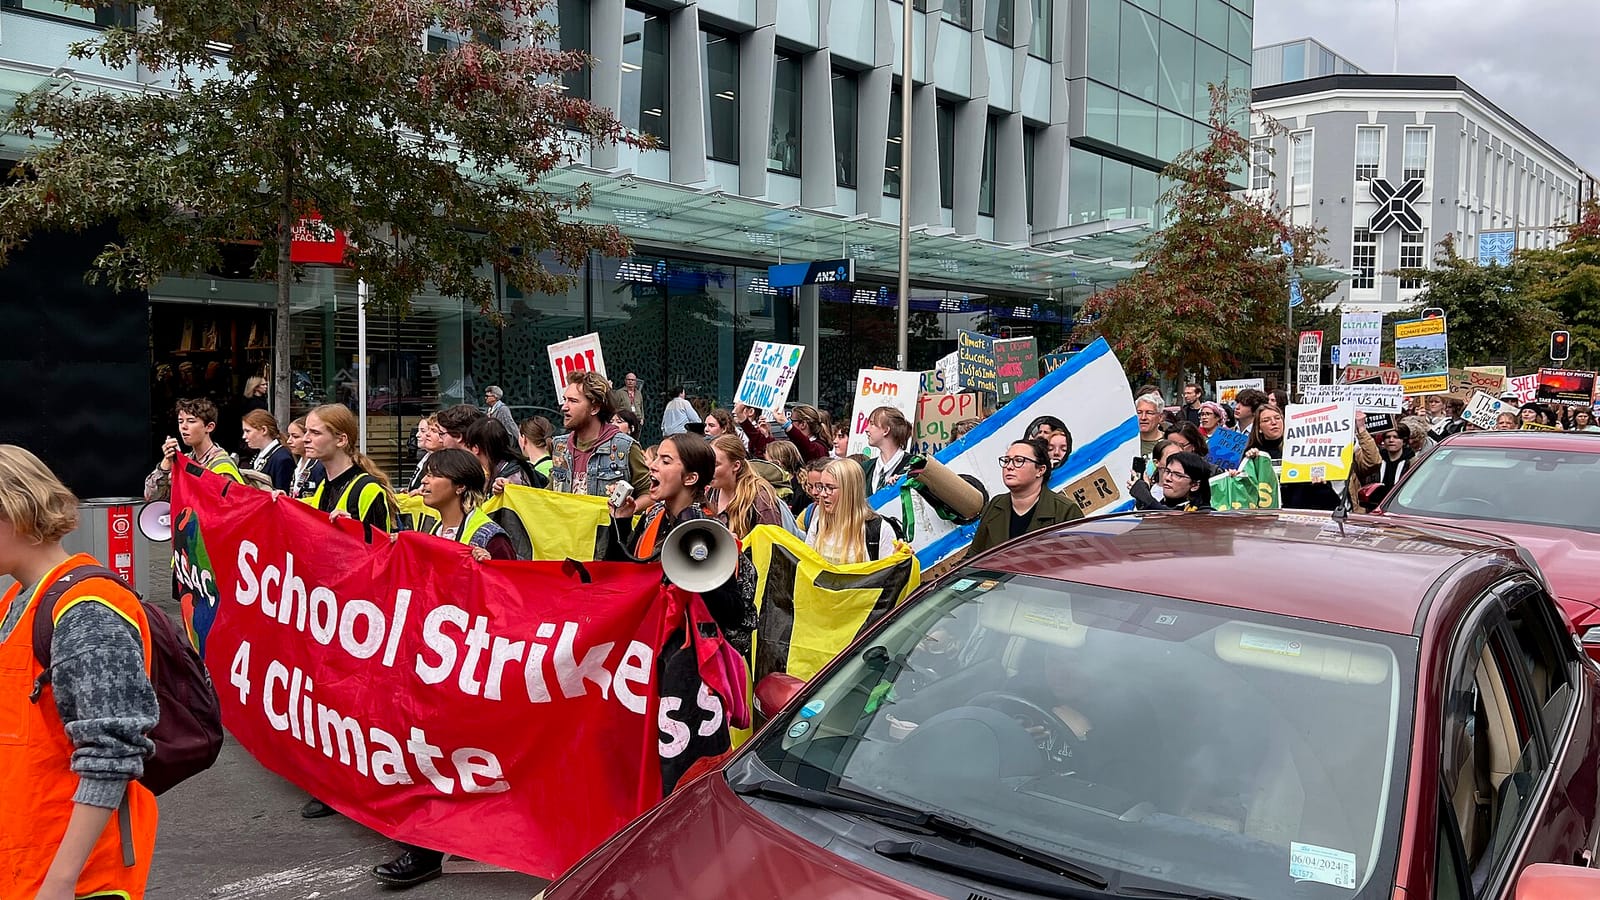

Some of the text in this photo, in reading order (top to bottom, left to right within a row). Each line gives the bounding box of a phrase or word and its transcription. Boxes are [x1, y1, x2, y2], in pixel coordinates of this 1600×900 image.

[815, 271, 836, 282] ANZ
[960, 332, 986, 349] Climate
[960, 348, 994, 366] Education
[1470, 371, 1504, 389] Social
[1357, 397, 1372, 405] US
[1373, 397, 1398, 407] ALL
[1304, 416, 1317, 424] FOR
[1287, 419, 1350, 440] ANIMALS
[1291, 445, 1345, 457] PLANET
[235, 539, 412, 667] School
[415, 604, 654, 714] Strike
[230, 640, 510, 794] 4 Climate
[1291, 854, 1341, 871] 06/04/2024
